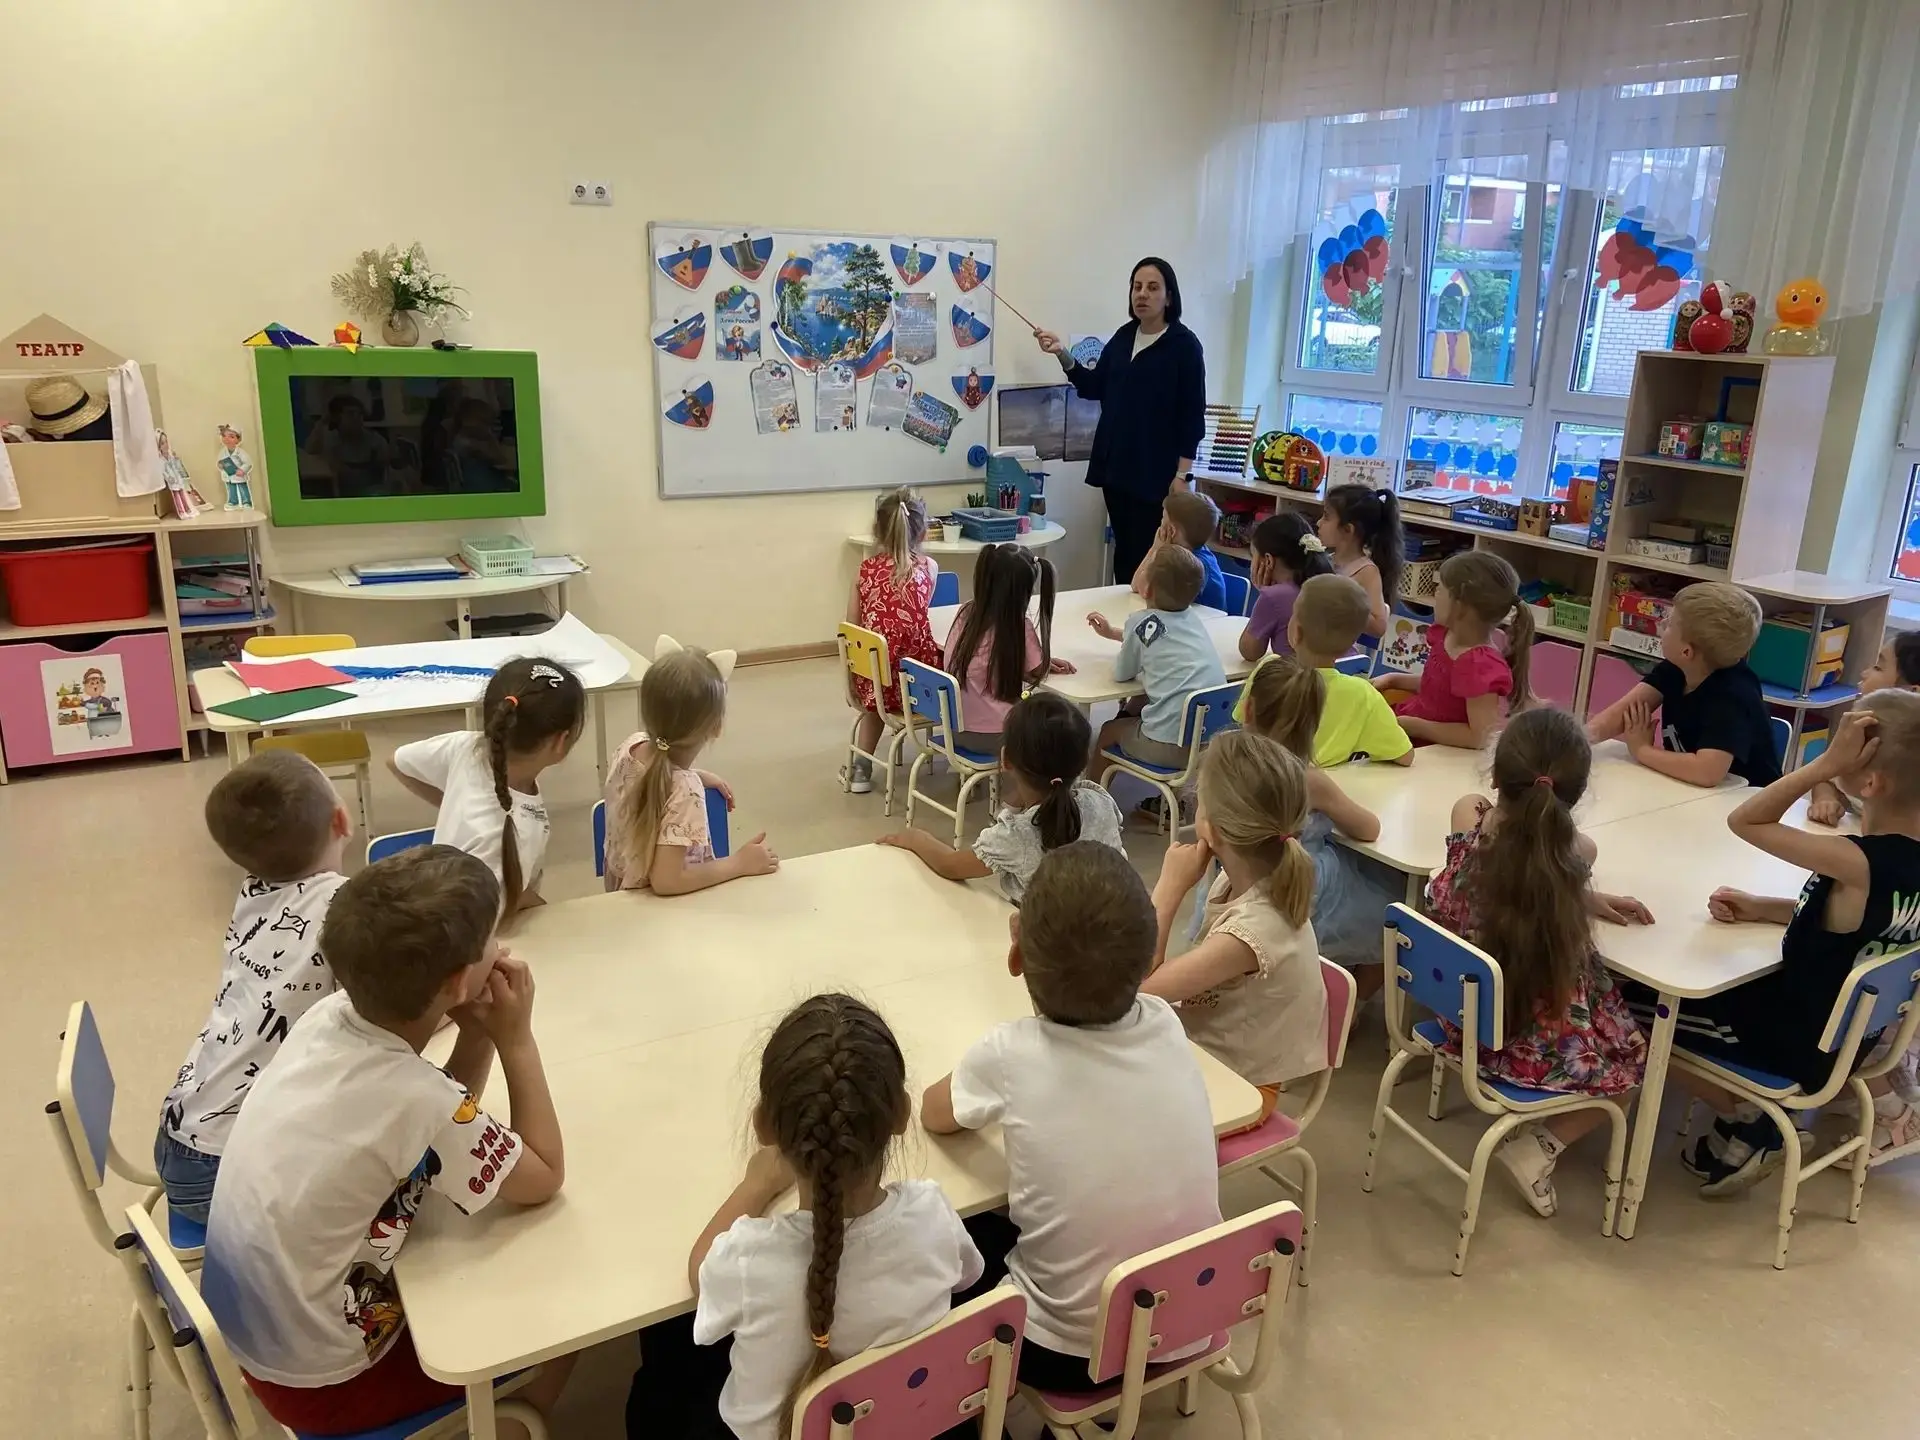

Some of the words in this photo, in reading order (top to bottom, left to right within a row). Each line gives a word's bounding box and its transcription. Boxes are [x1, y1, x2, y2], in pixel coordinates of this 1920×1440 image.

[16, 343, 84, 357] ТЕАТР
[1707, 424, 1719, 434] IQ
[1369, 460, 1385, 468] ring
